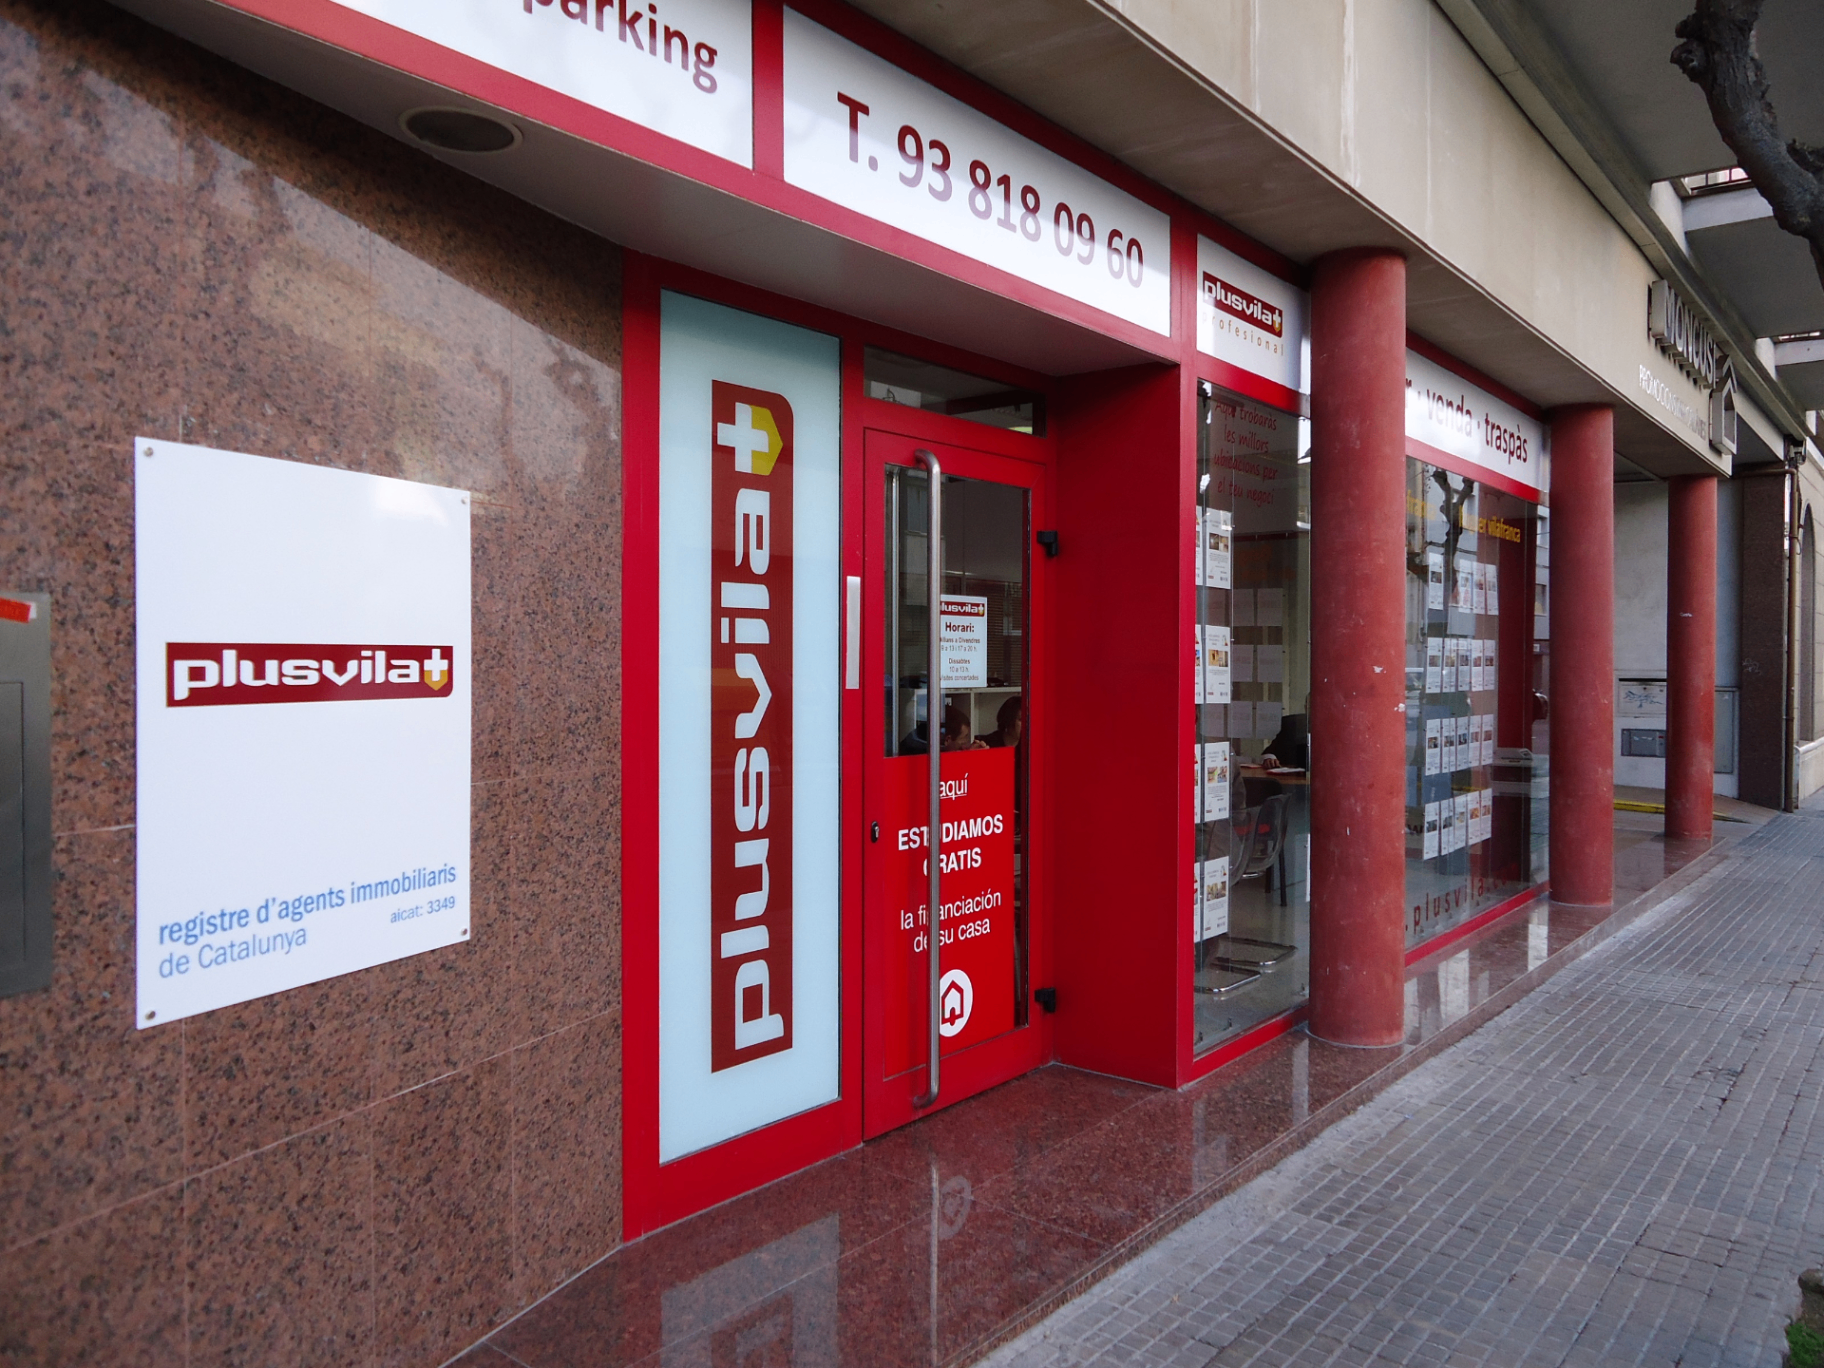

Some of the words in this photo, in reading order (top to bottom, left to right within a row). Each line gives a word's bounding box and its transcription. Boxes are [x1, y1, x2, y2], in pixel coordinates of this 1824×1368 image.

[523, 0, 718, 94] arking
[836, 91, 881, 173] T.
[897, 123, 954, 204] 93
[967, 158, 1043, 244] 818
[1053, 200, 1097, 267] 09
[1106, 226, 1145, 290] 60
[1202, 311, 1285, 357] profesional
[1239, 405, 1278, 431] trobaràs
[1426, 388, 1473, 438] venda
[1484, 412, 1529, 466] traspàs
[1223, 423, 1236, 444] les
[1239, 431, 1270, 454] millors
[1217, 475, 1226, 494] el
[1246, 488, 1275, 508] negoci
[945, 621, 975, 633] Horari:
[897, 813, 1004, 851] ESTDIAMOS
[923, 847, 982, 877] RATIS
[157, 894, 250, 949] registre
[349, 862, 458, 909] immobiliaris
[900, 910, 914, 931] la
[917, 888, 1002, 926] fianciación
[158, 950, 191, 980] de
[197, 925, 308, 971] Catalunya
[389, 902, 424, 925] aicat:
[426, 894, 457, 915] 3349
[913, 934, 928, 953] de
[939, 928, 955, 946] su
[957, 917, 991, 941] casa
